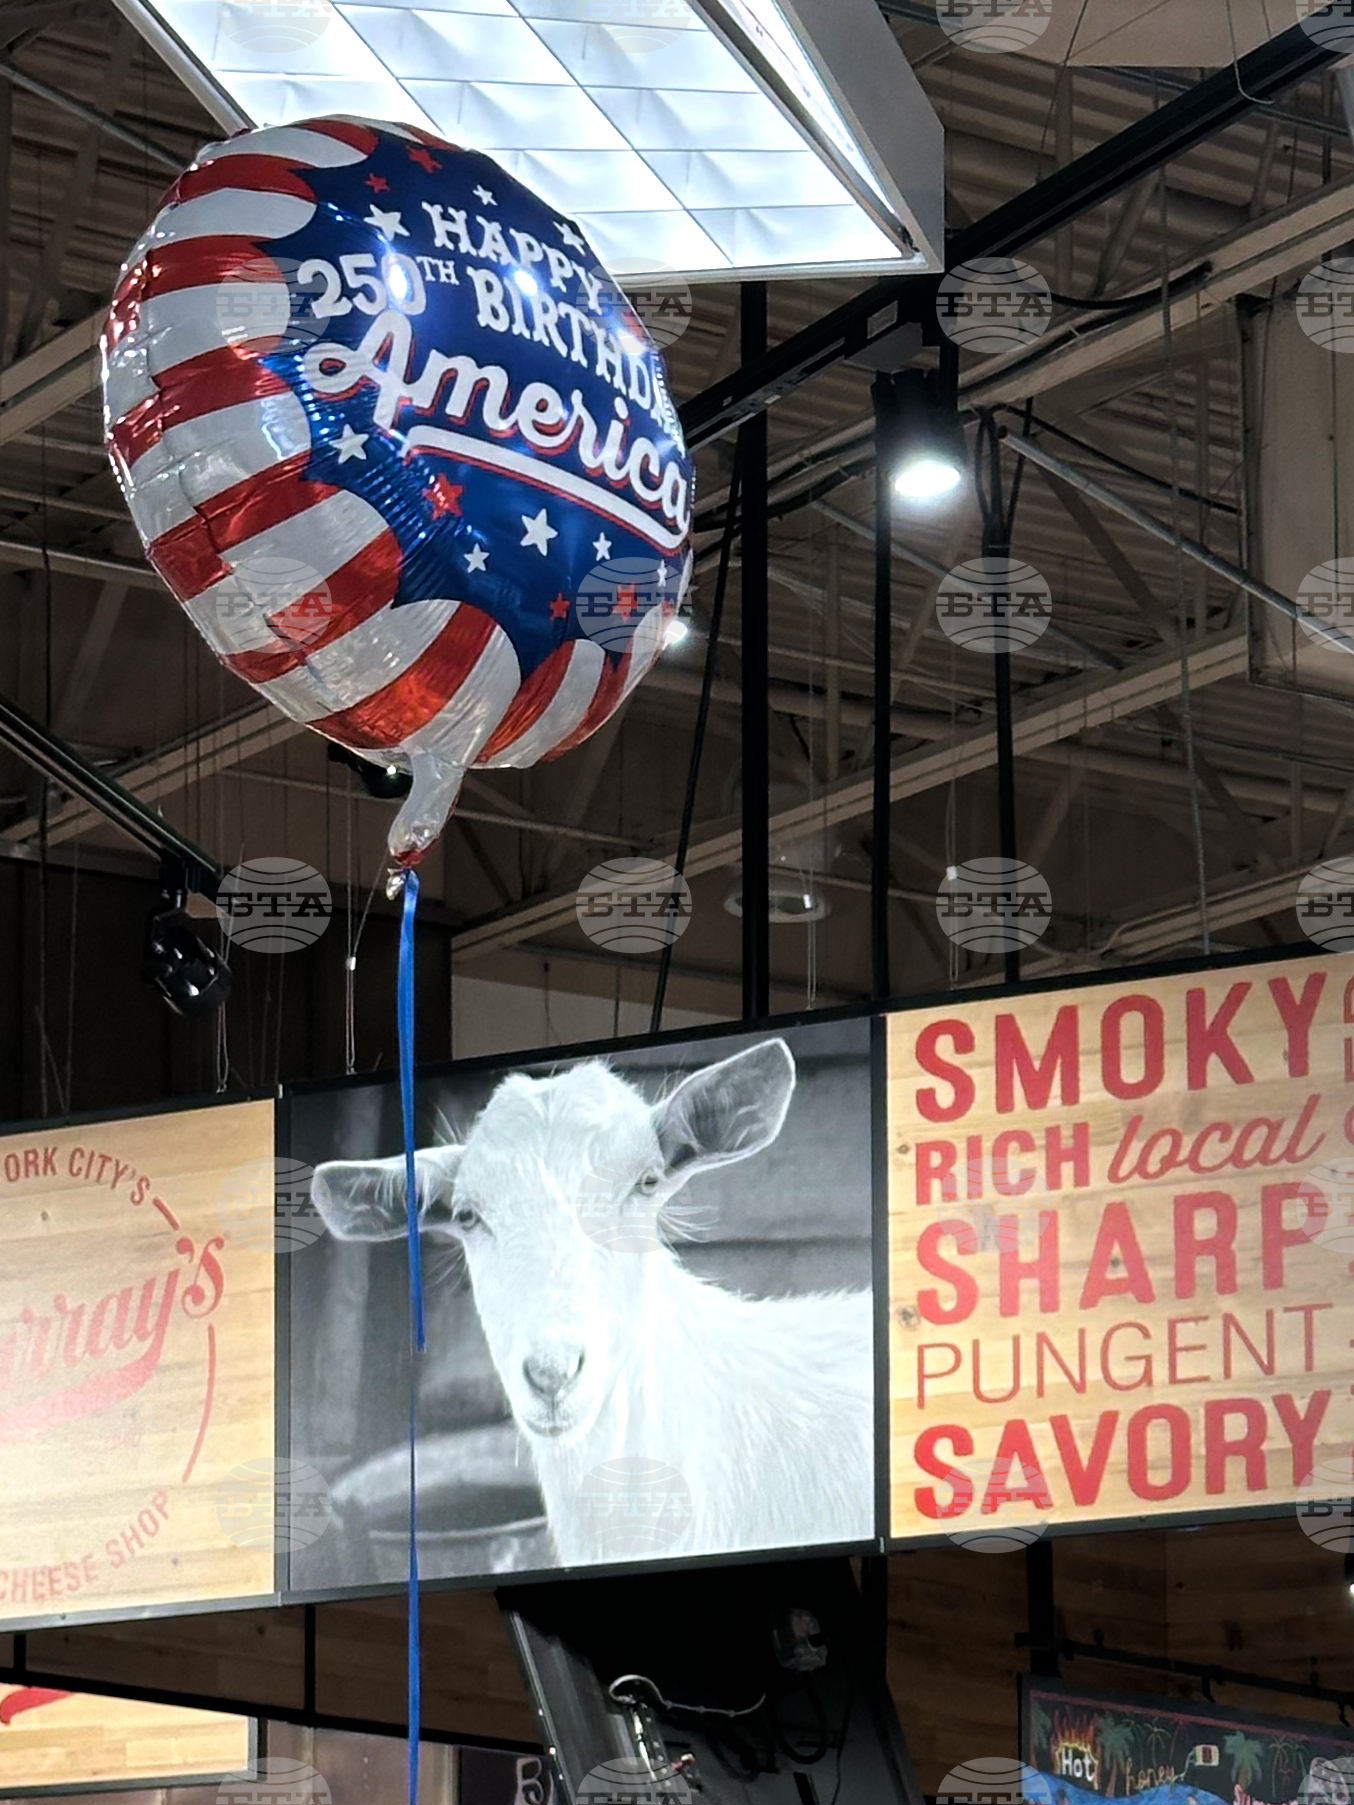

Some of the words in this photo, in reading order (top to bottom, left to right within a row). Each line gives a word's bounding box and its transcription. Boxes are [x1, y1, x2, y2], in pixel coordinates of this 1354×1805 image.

[421, 200, 604, 315] HAPPY
[303, 309, 690, 537] America
[914, 971, 1328, 1123] SMOKY
[3, 1147, 58, 1183] ORK
[69, 1147, 151, 1206] CITY'S
[914, 1121, 1091, 1205] RICH
[1107, 1092, 1328, 1184] local
[915, 1181, 1328, 1325] SHARP
[915, 1302, 1334, 1408] PUNGENT
[913, 1389, 1331, 1519] SAVORY
[105, 1486, 170, 1569] SHOP
[1061, 1748, 1096, 1782] Hot
